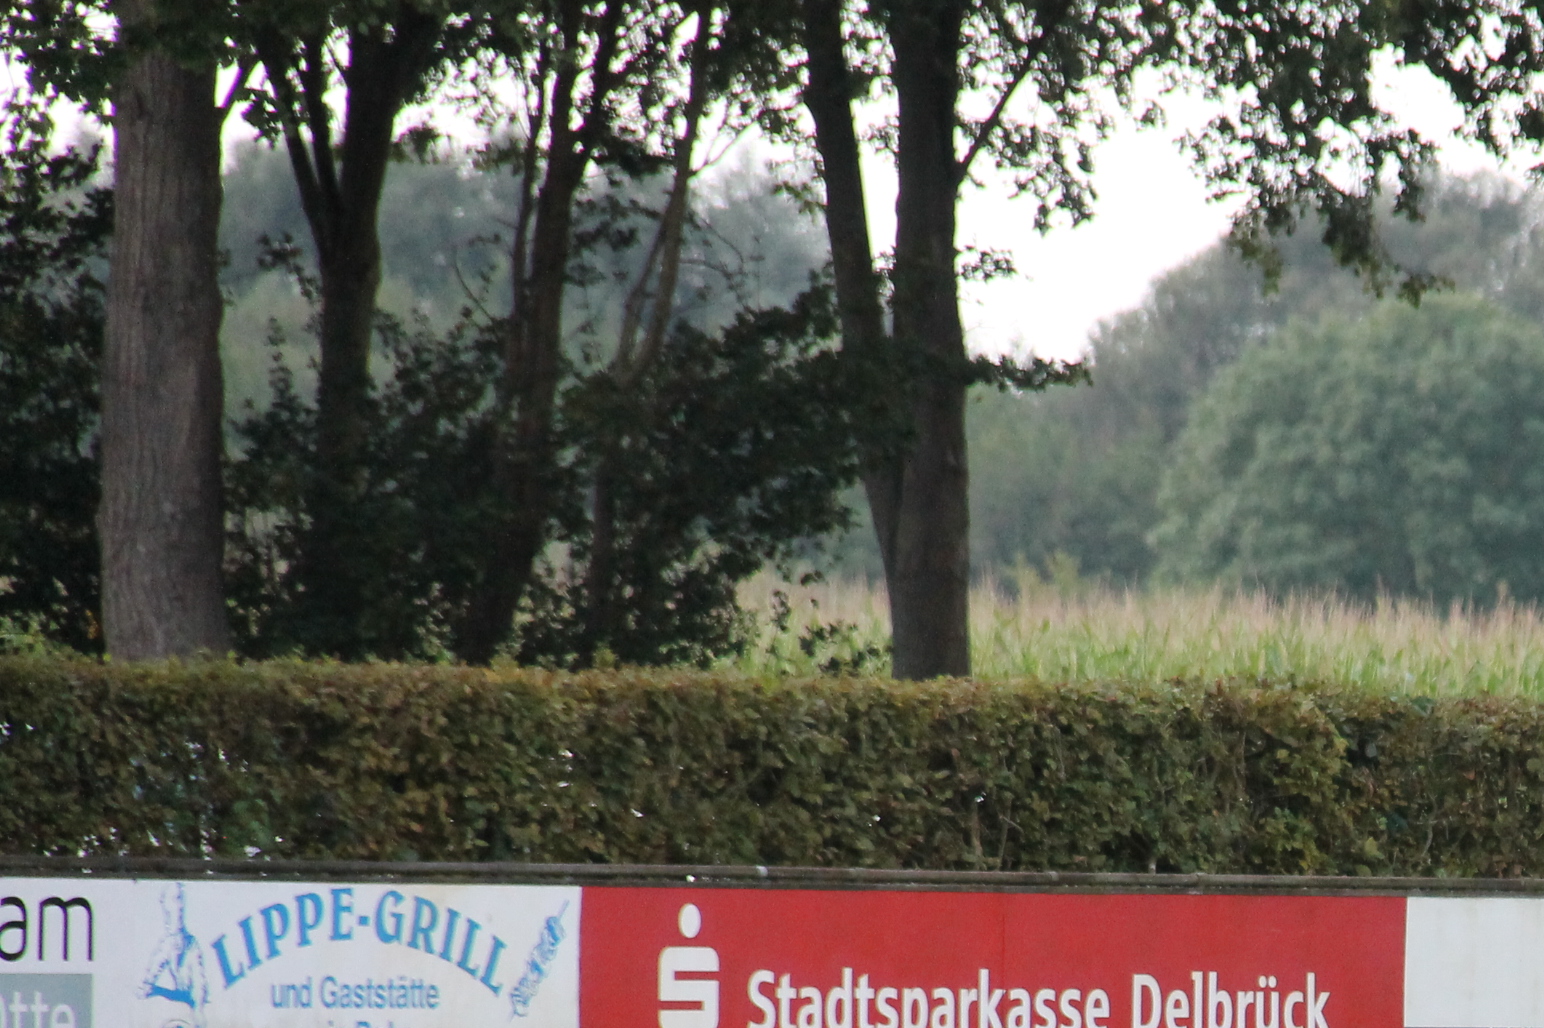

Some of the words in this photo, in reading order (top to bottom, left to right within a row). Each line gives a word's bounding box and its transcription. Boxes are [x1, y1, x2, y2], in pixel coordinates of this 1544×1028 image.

[210, 888, 508, 997] LIPPE-GRILL
[271, 976, 312, 1008] und
[321, 975, 440, 1010] Gaststätte
